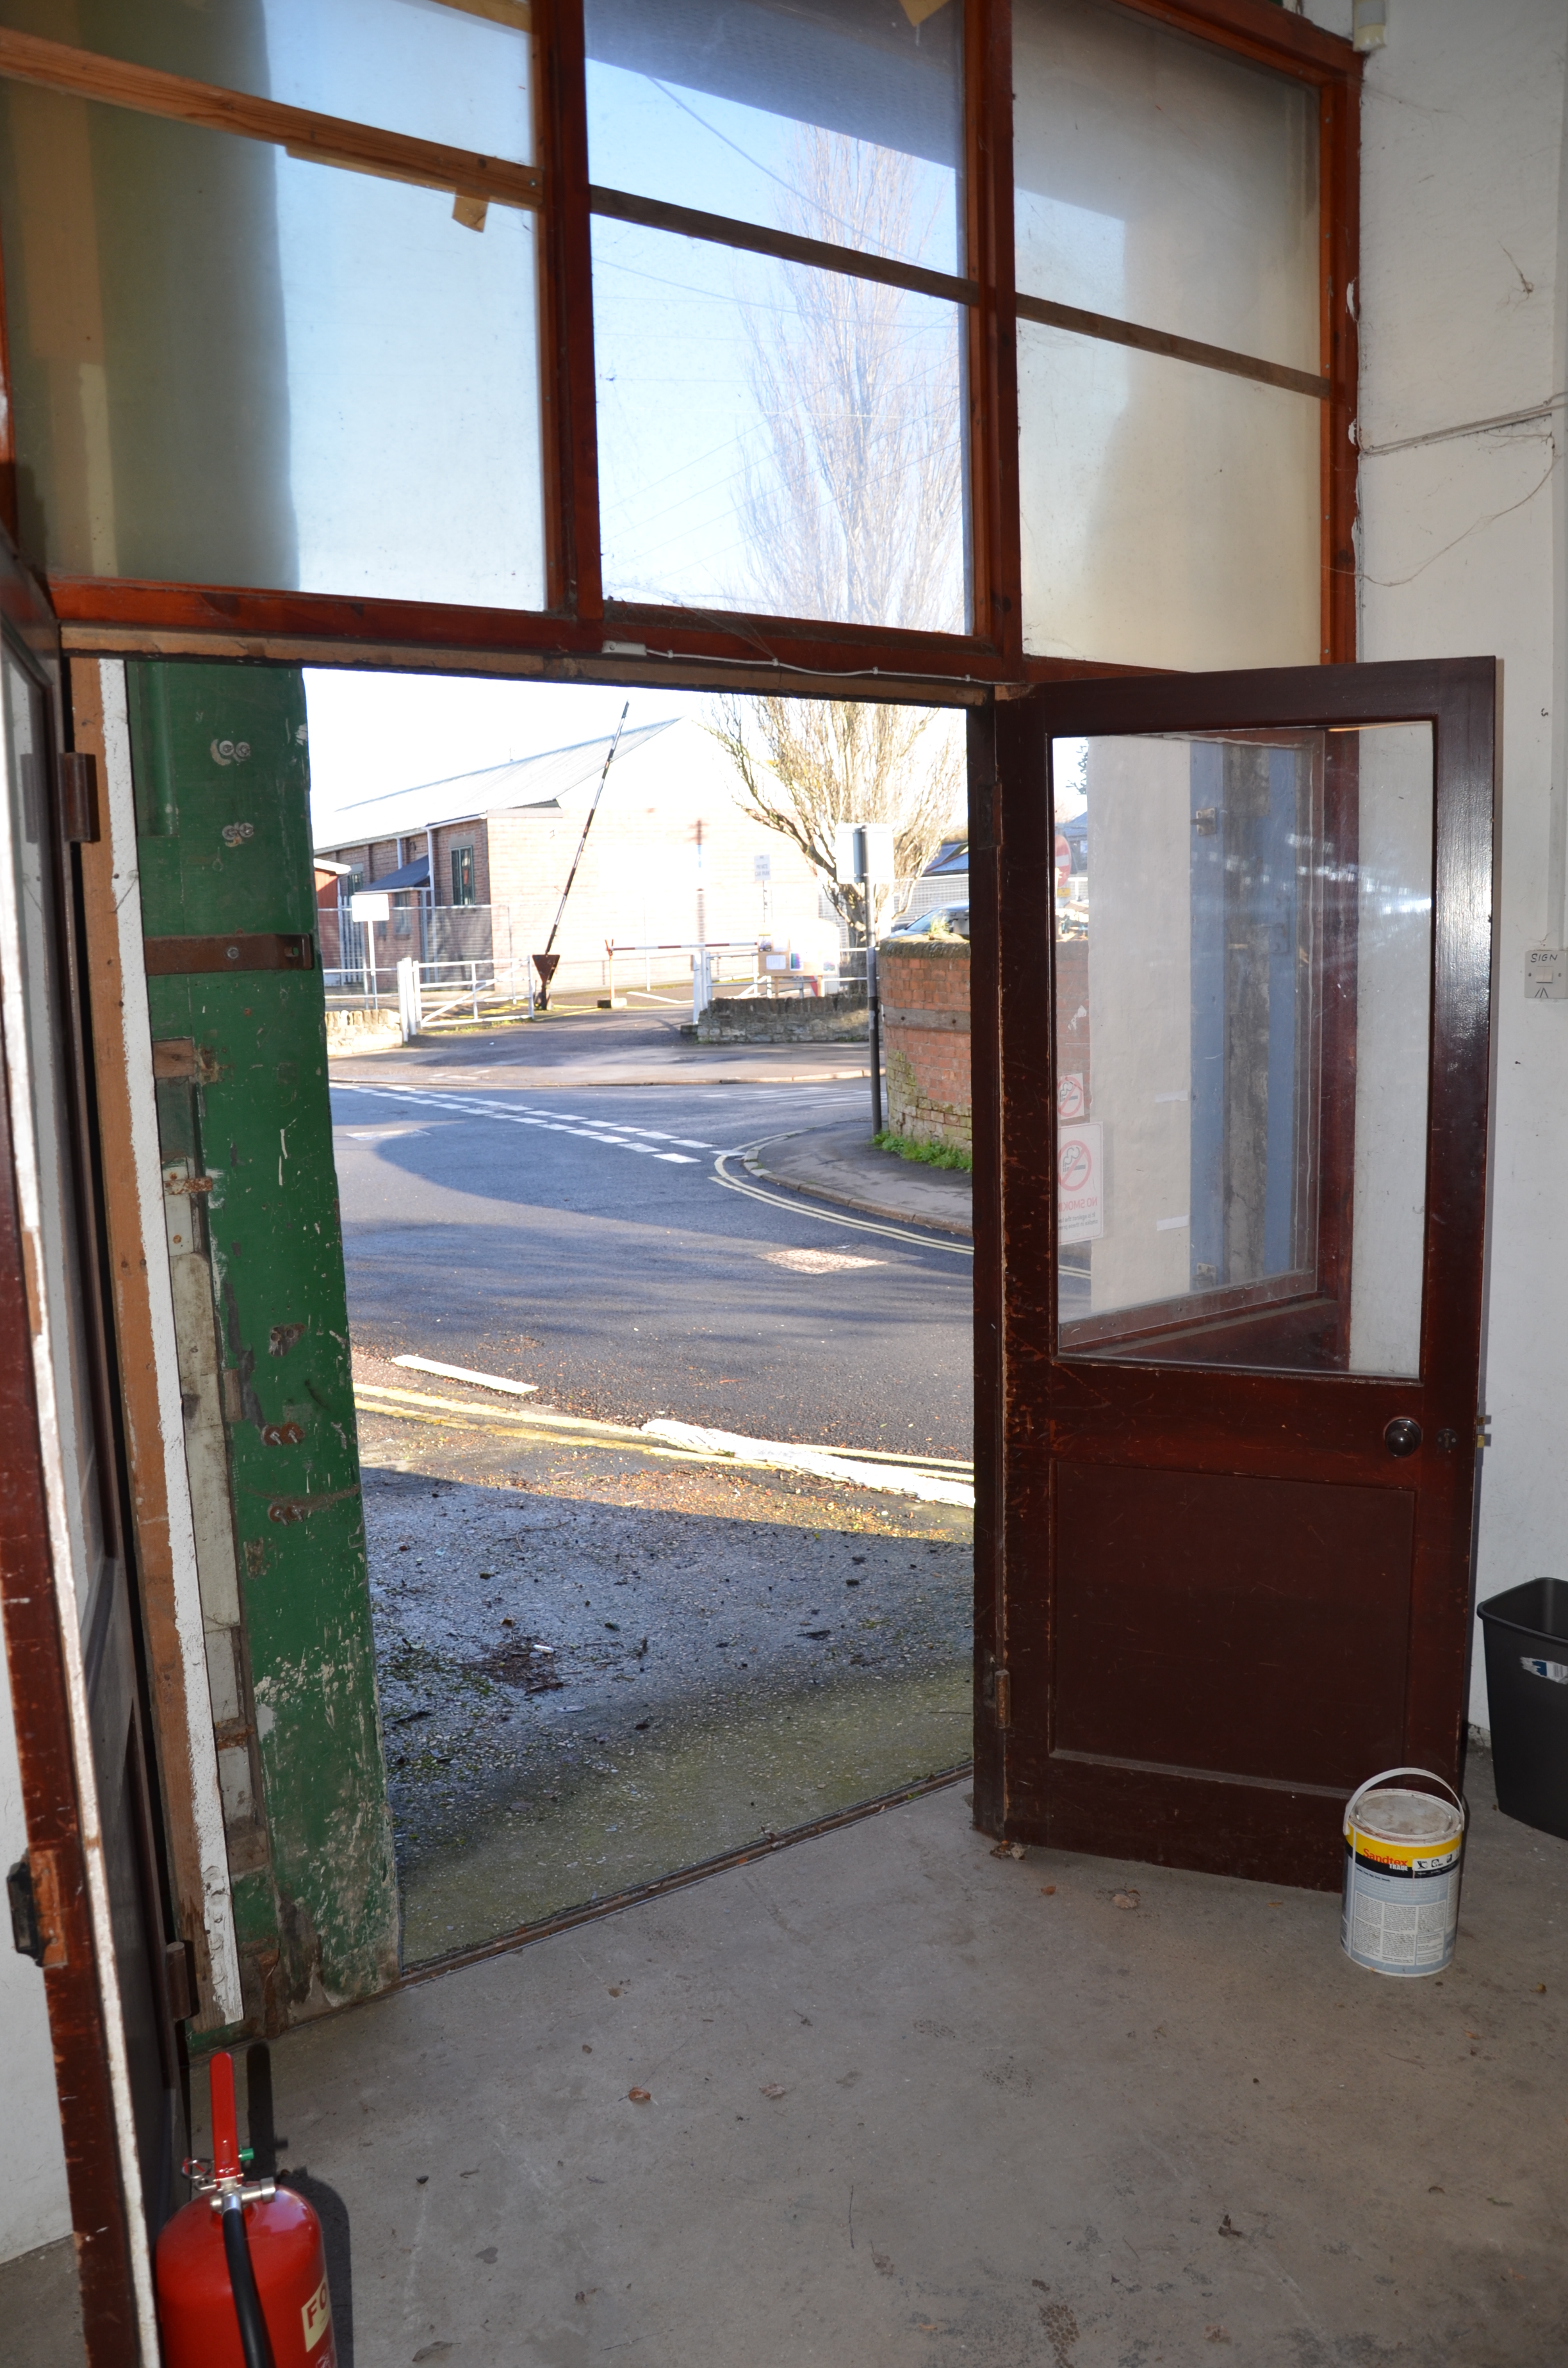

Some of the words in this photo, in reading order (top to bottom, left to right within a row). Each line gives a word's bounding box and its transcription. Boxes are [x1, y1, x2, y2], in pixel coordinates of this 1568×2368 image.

[1530, 953, 1558, 962] SIGN
[1363, 1848, 1408, 1866] Sandtex
[1389, 1863, 1409, 1871] TRADE
